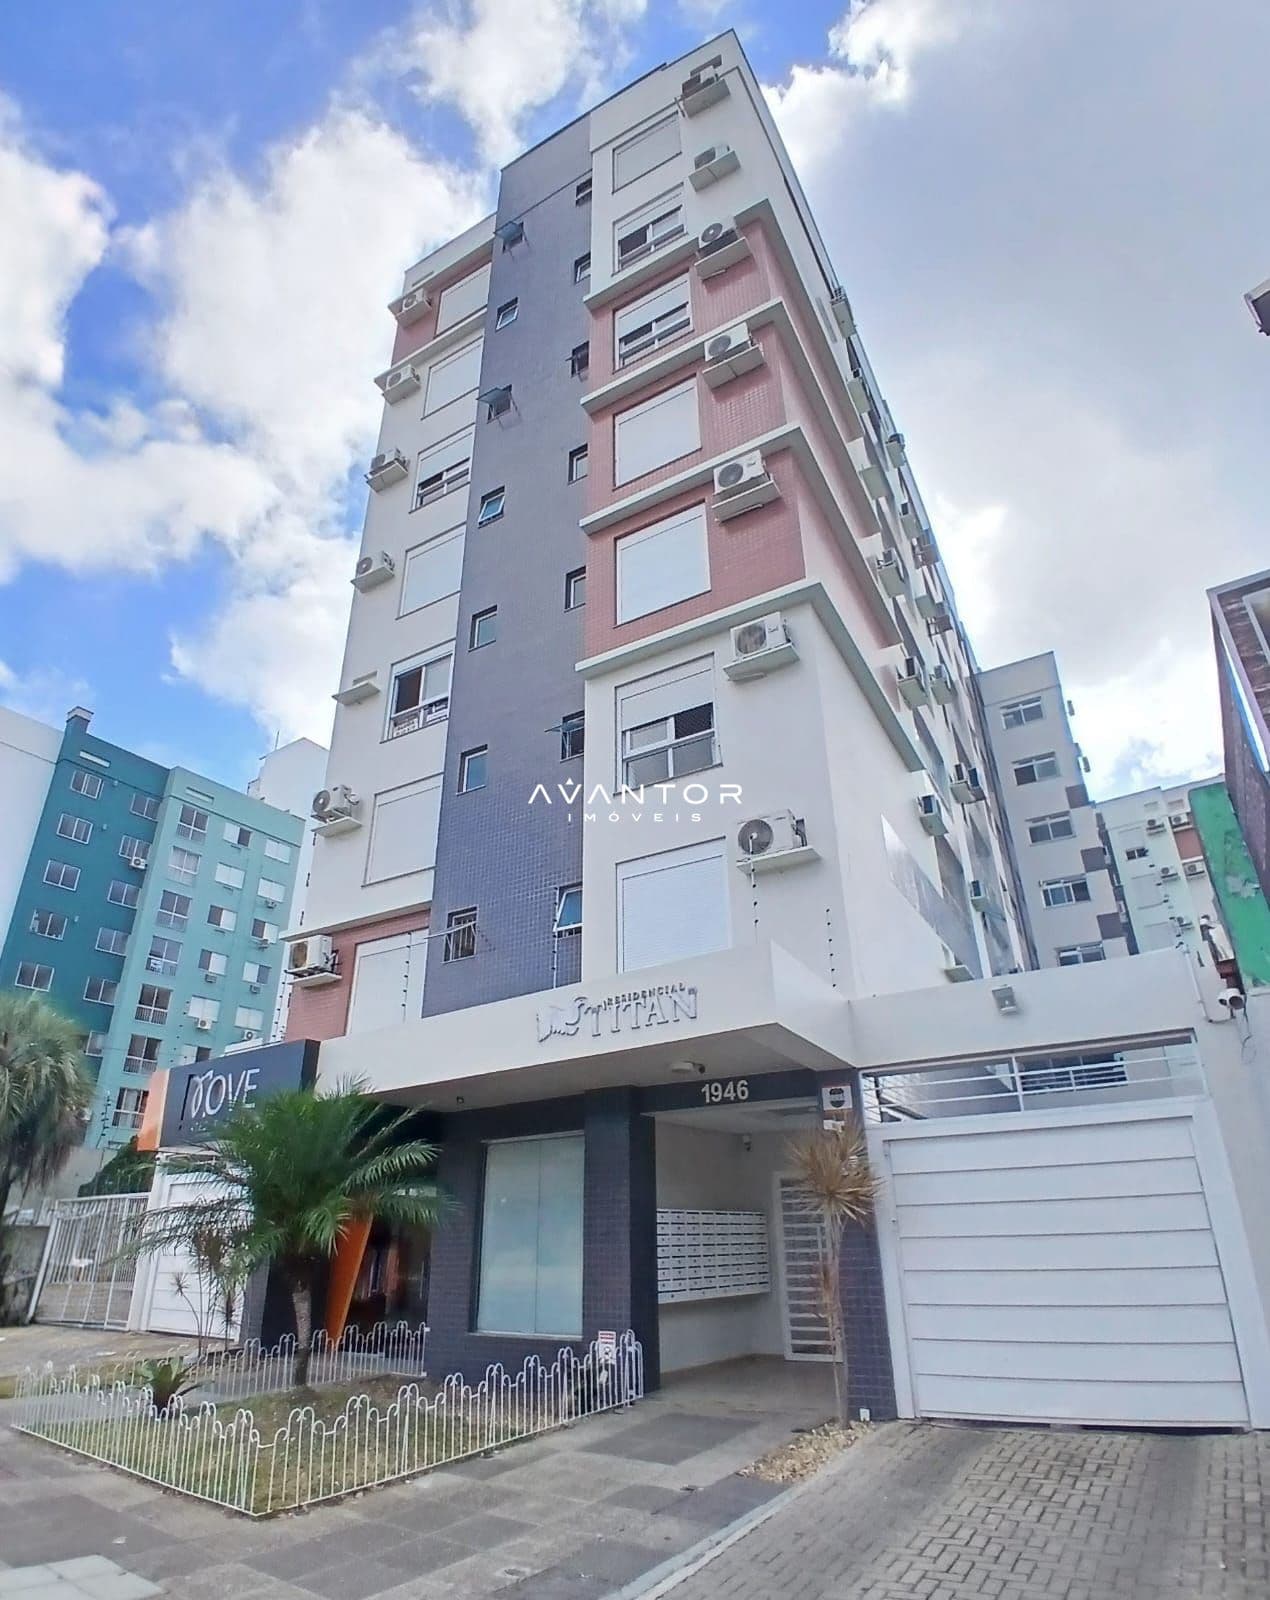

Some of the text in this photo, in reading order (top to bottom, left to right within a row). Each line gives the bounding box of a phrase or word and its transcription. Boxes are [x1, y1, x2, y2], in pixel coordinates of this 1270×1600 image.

[607, 982, 685, 1007] RESIDENCIAL
[591, 989, 698, 1037] TITAN
[701, 1079, 749, 1103] 1946
